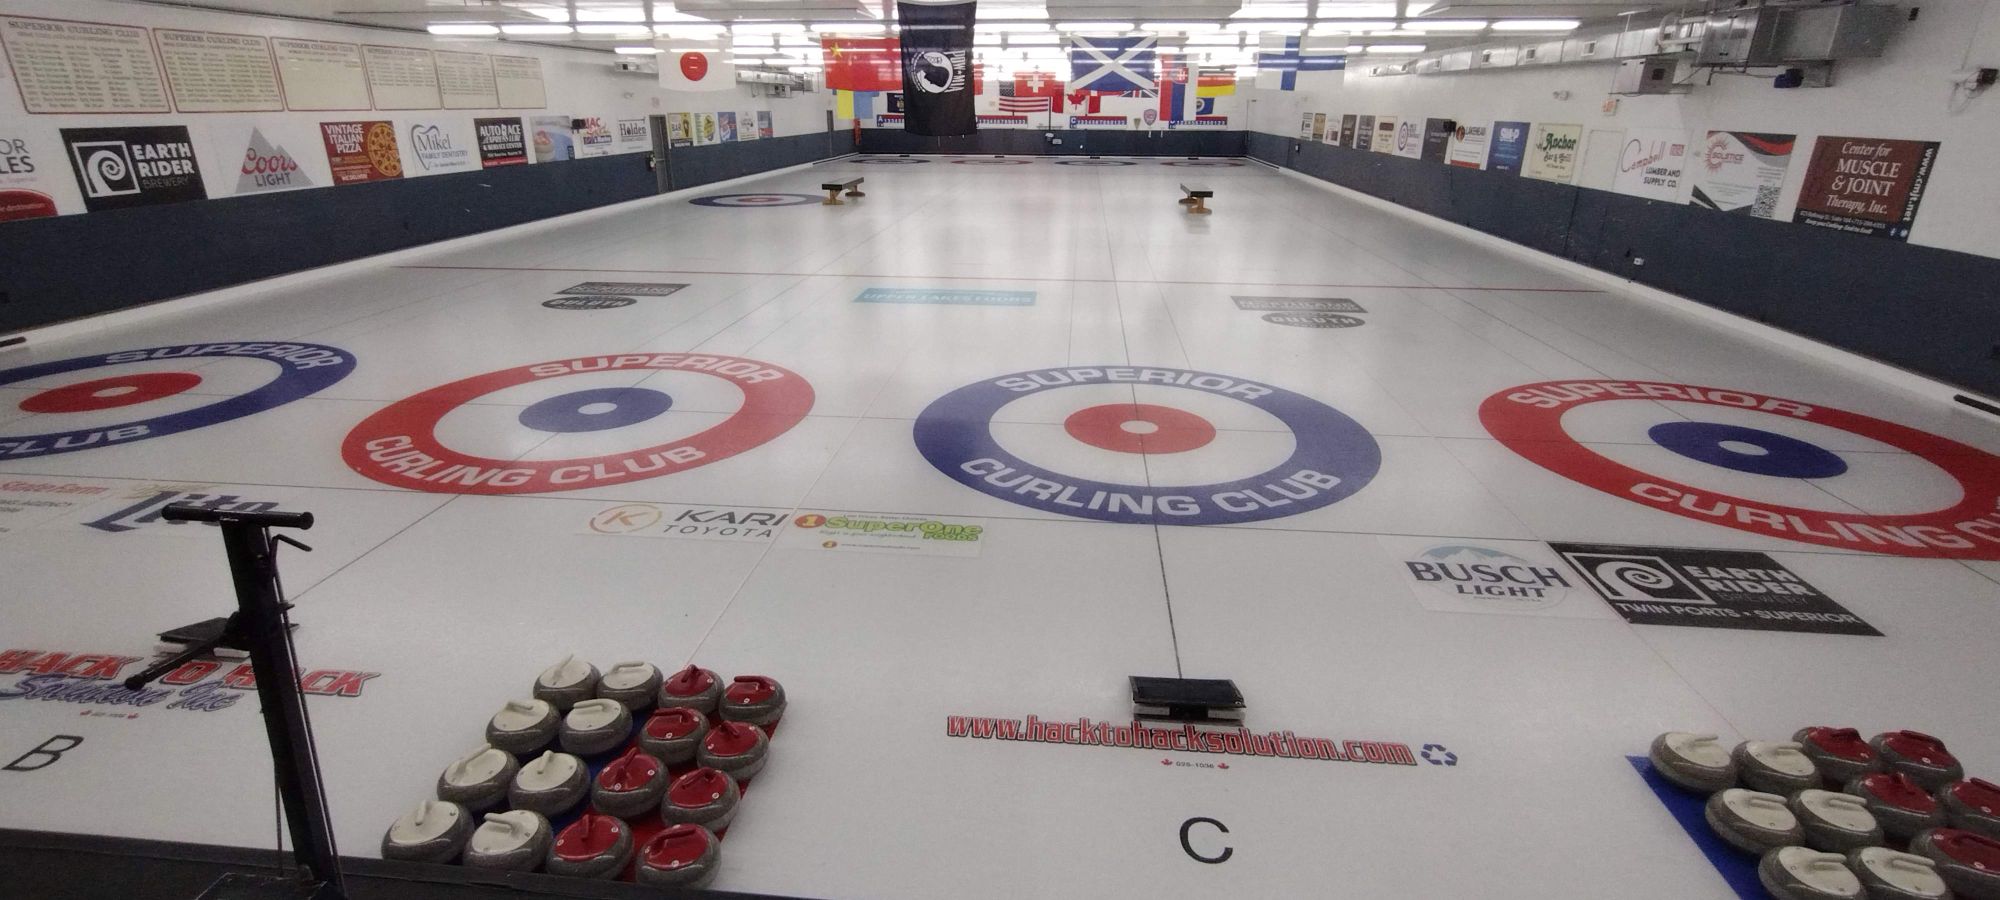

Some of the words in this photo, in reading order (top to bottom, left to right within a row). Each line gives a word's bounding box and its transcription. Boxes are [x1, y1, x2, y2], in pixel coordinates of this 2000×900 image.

[8, 20, 64, 32] SUPERIOR
[325, 124, 364, 134] VINTAGE
[329, 134, 364, 144] ITALIAN
[337, 143, 363, 153] PIZZA
[417, 133, 452, 151] Mikel
[131, 142, 192, 161] EARTH
[1842, 142, 1873, 155] Center
[1872, 143, 1893, 160] for
[137, 159, 195, 178] RIDER
[241, 147, 297, 175] Coors
[1836, 158, 1901, 178] MUSCLE
[142, 176, 190, 189] BREWERY
[255, 172, 292, 187] LIGHT
[1643, 176, 1666, 186] SUPPLY
[1667, 169, 1680, 177] AND
[1831, 175, 1847, 190] &
[1843, 177, 1895, 197] JOINT
[1826, 194, 1866, 214] Therapy,
[1868, 200, 1888, 214] Inc.
[1271, 315, 1357, 324] DULUTH
[106, 343, 344, 371] SUPERIOR
[529, 354, 786, 384] SUPERIOR
[995, 368, 1274, 400] SUPERIOR
[1507, 381, 1815, 418] SUPERIOR
[364, 434, 535, 488] CURLING
[548, 446, 707, 485] CLUB
[960, 457, 1202, 517] CURLING
[1210, 468, 1343, 515] CLUB
[675, 509, 789, 526] KARI
[1630, 482, 1977, 549] CURLING
[663, 524, 773, 538] TOYOTA
[824, 516, 984, 535] SuperOne
[922, 531, 980, 542] FOODS
[1405, 560, 1573, 589] BUSCH
[1682, 565, 1801, 583] EARTH
[1455, 584, 1546, 598] LIGHT
[1700, 578, 1817, 597] RIDER
[1616, 602, 1670, 615] TWIN
[1674, 604, 1742, 619] PORTS
[1753, 609, 1863, 625] SUPERIOR
[947, 714, 1419, 767] www.hacktohacksolution.com
[2, 734, 84, 772] B
[1179, 816, 1234, 865] C
